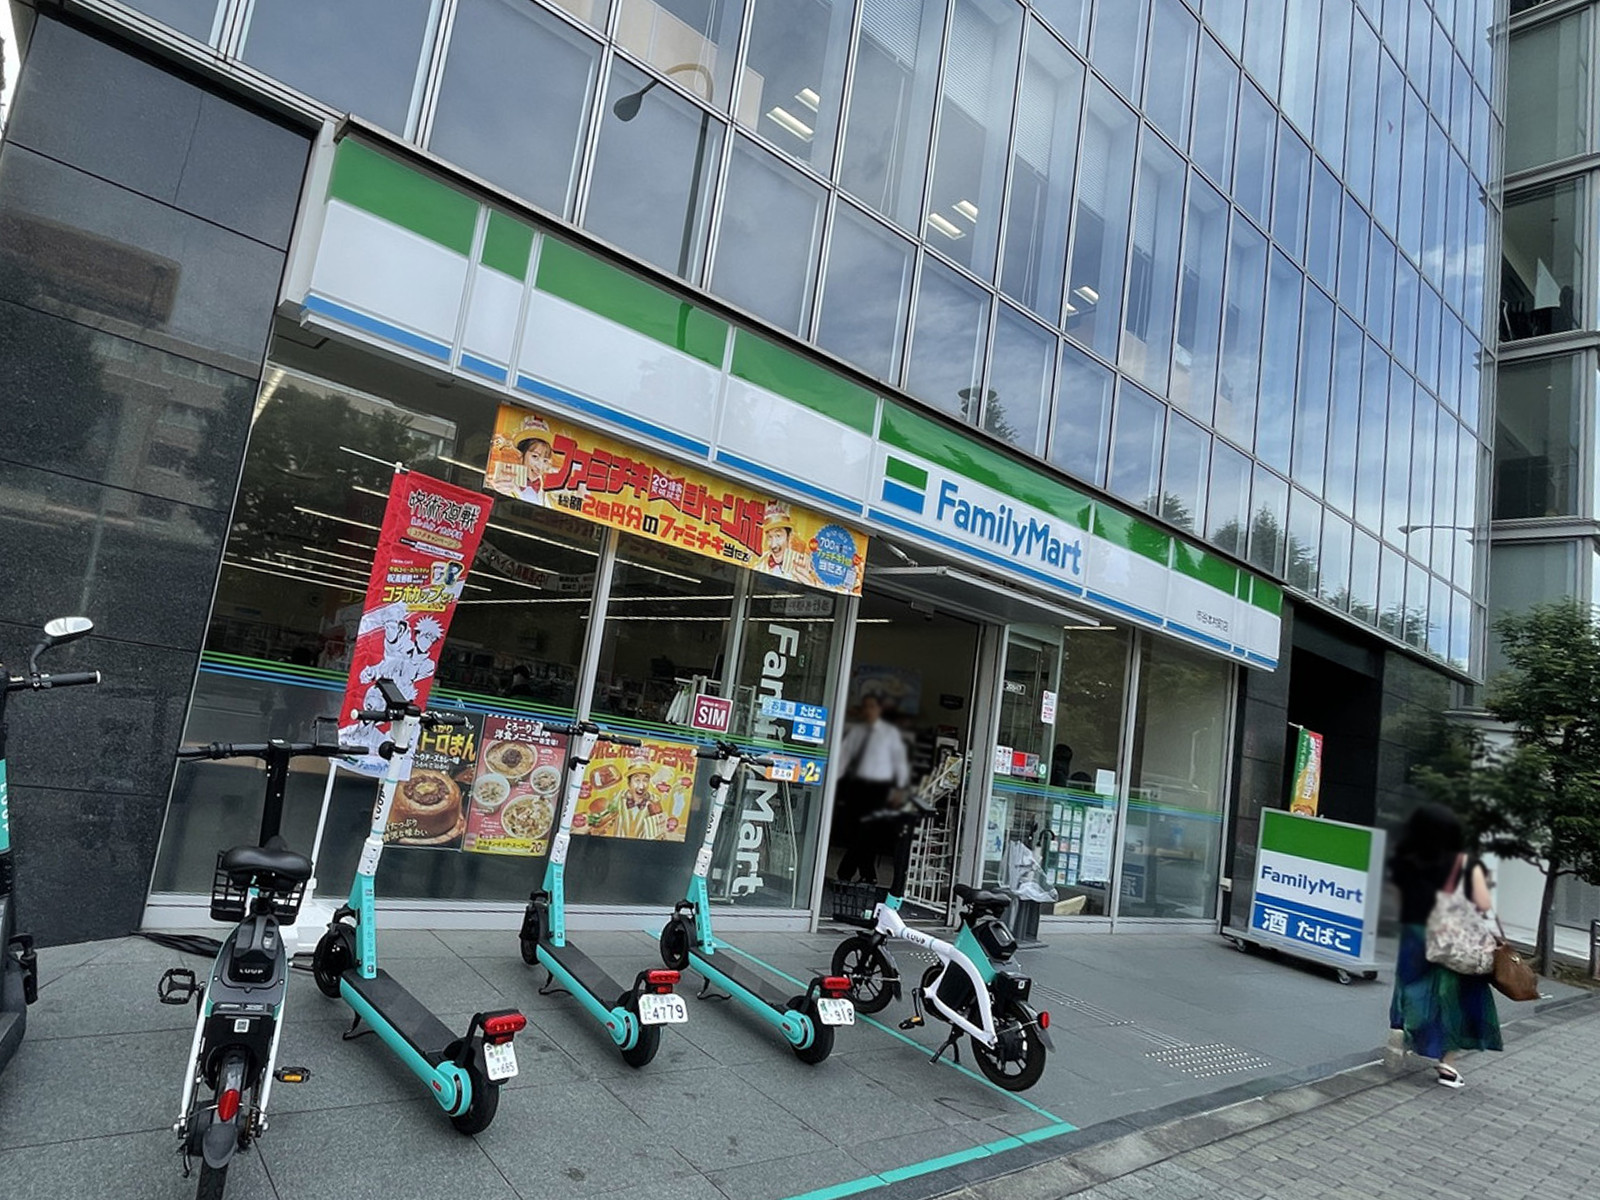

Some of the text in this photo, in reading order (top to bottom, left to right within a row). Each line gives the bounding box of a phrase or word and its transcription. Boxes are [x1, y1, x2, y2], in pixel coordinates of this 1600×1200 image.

[542, 435, 766, 556] ファミチキ ジャンボ
[936, 479, 1081, 576] FamilyMart
[698, 706, 726, 728] SIM
[799, 705, 823, 720] たばこ
[415, 732, 476, 763] トロまん
[1261, 865, 1363, 903] FamilyMart
[1262, 909, 1351, 951] 酒 たばこ
[652, 1004, 685, 1021] 4779
